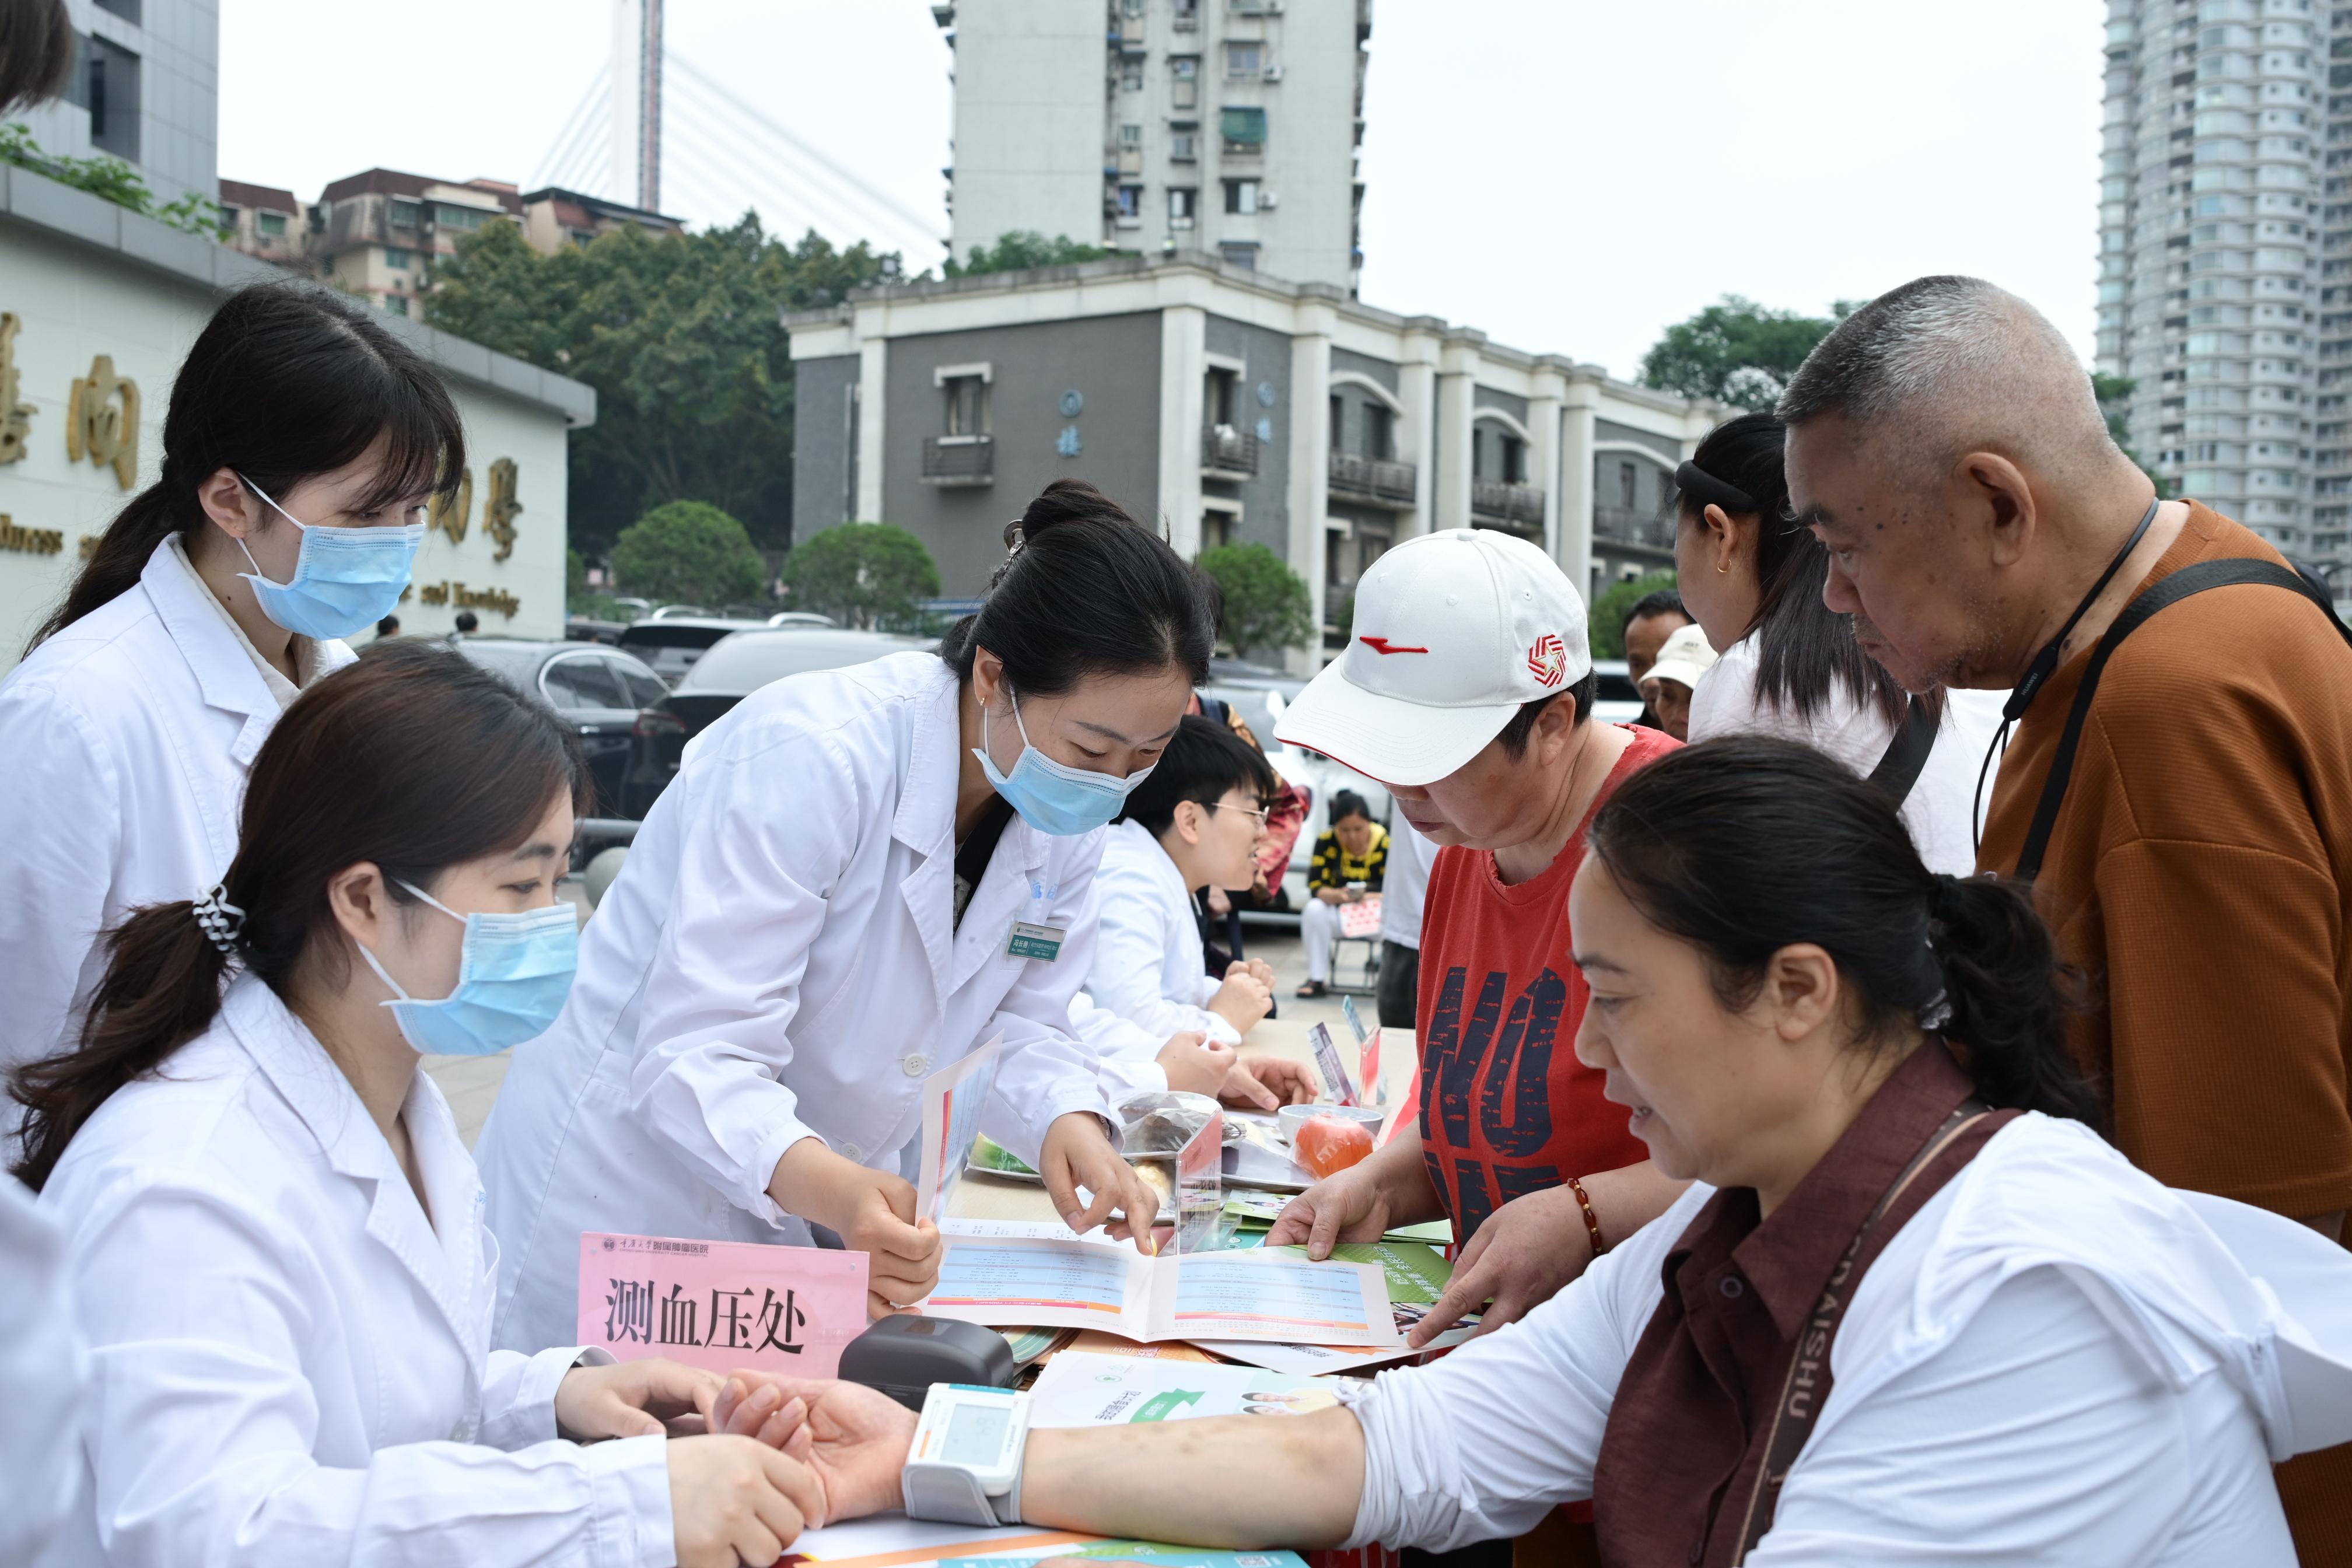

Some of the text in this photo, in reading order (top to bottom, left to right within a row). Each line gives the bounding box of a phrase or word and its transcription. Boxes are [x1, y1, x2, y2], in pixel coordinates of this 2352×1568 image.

[2020, 672, 2039, 697] HUAWEI
[620, 1237, 709, 1254] 重庆大学附属肿瘤医院
[604, 1278, 806, 1354] 测血压处
